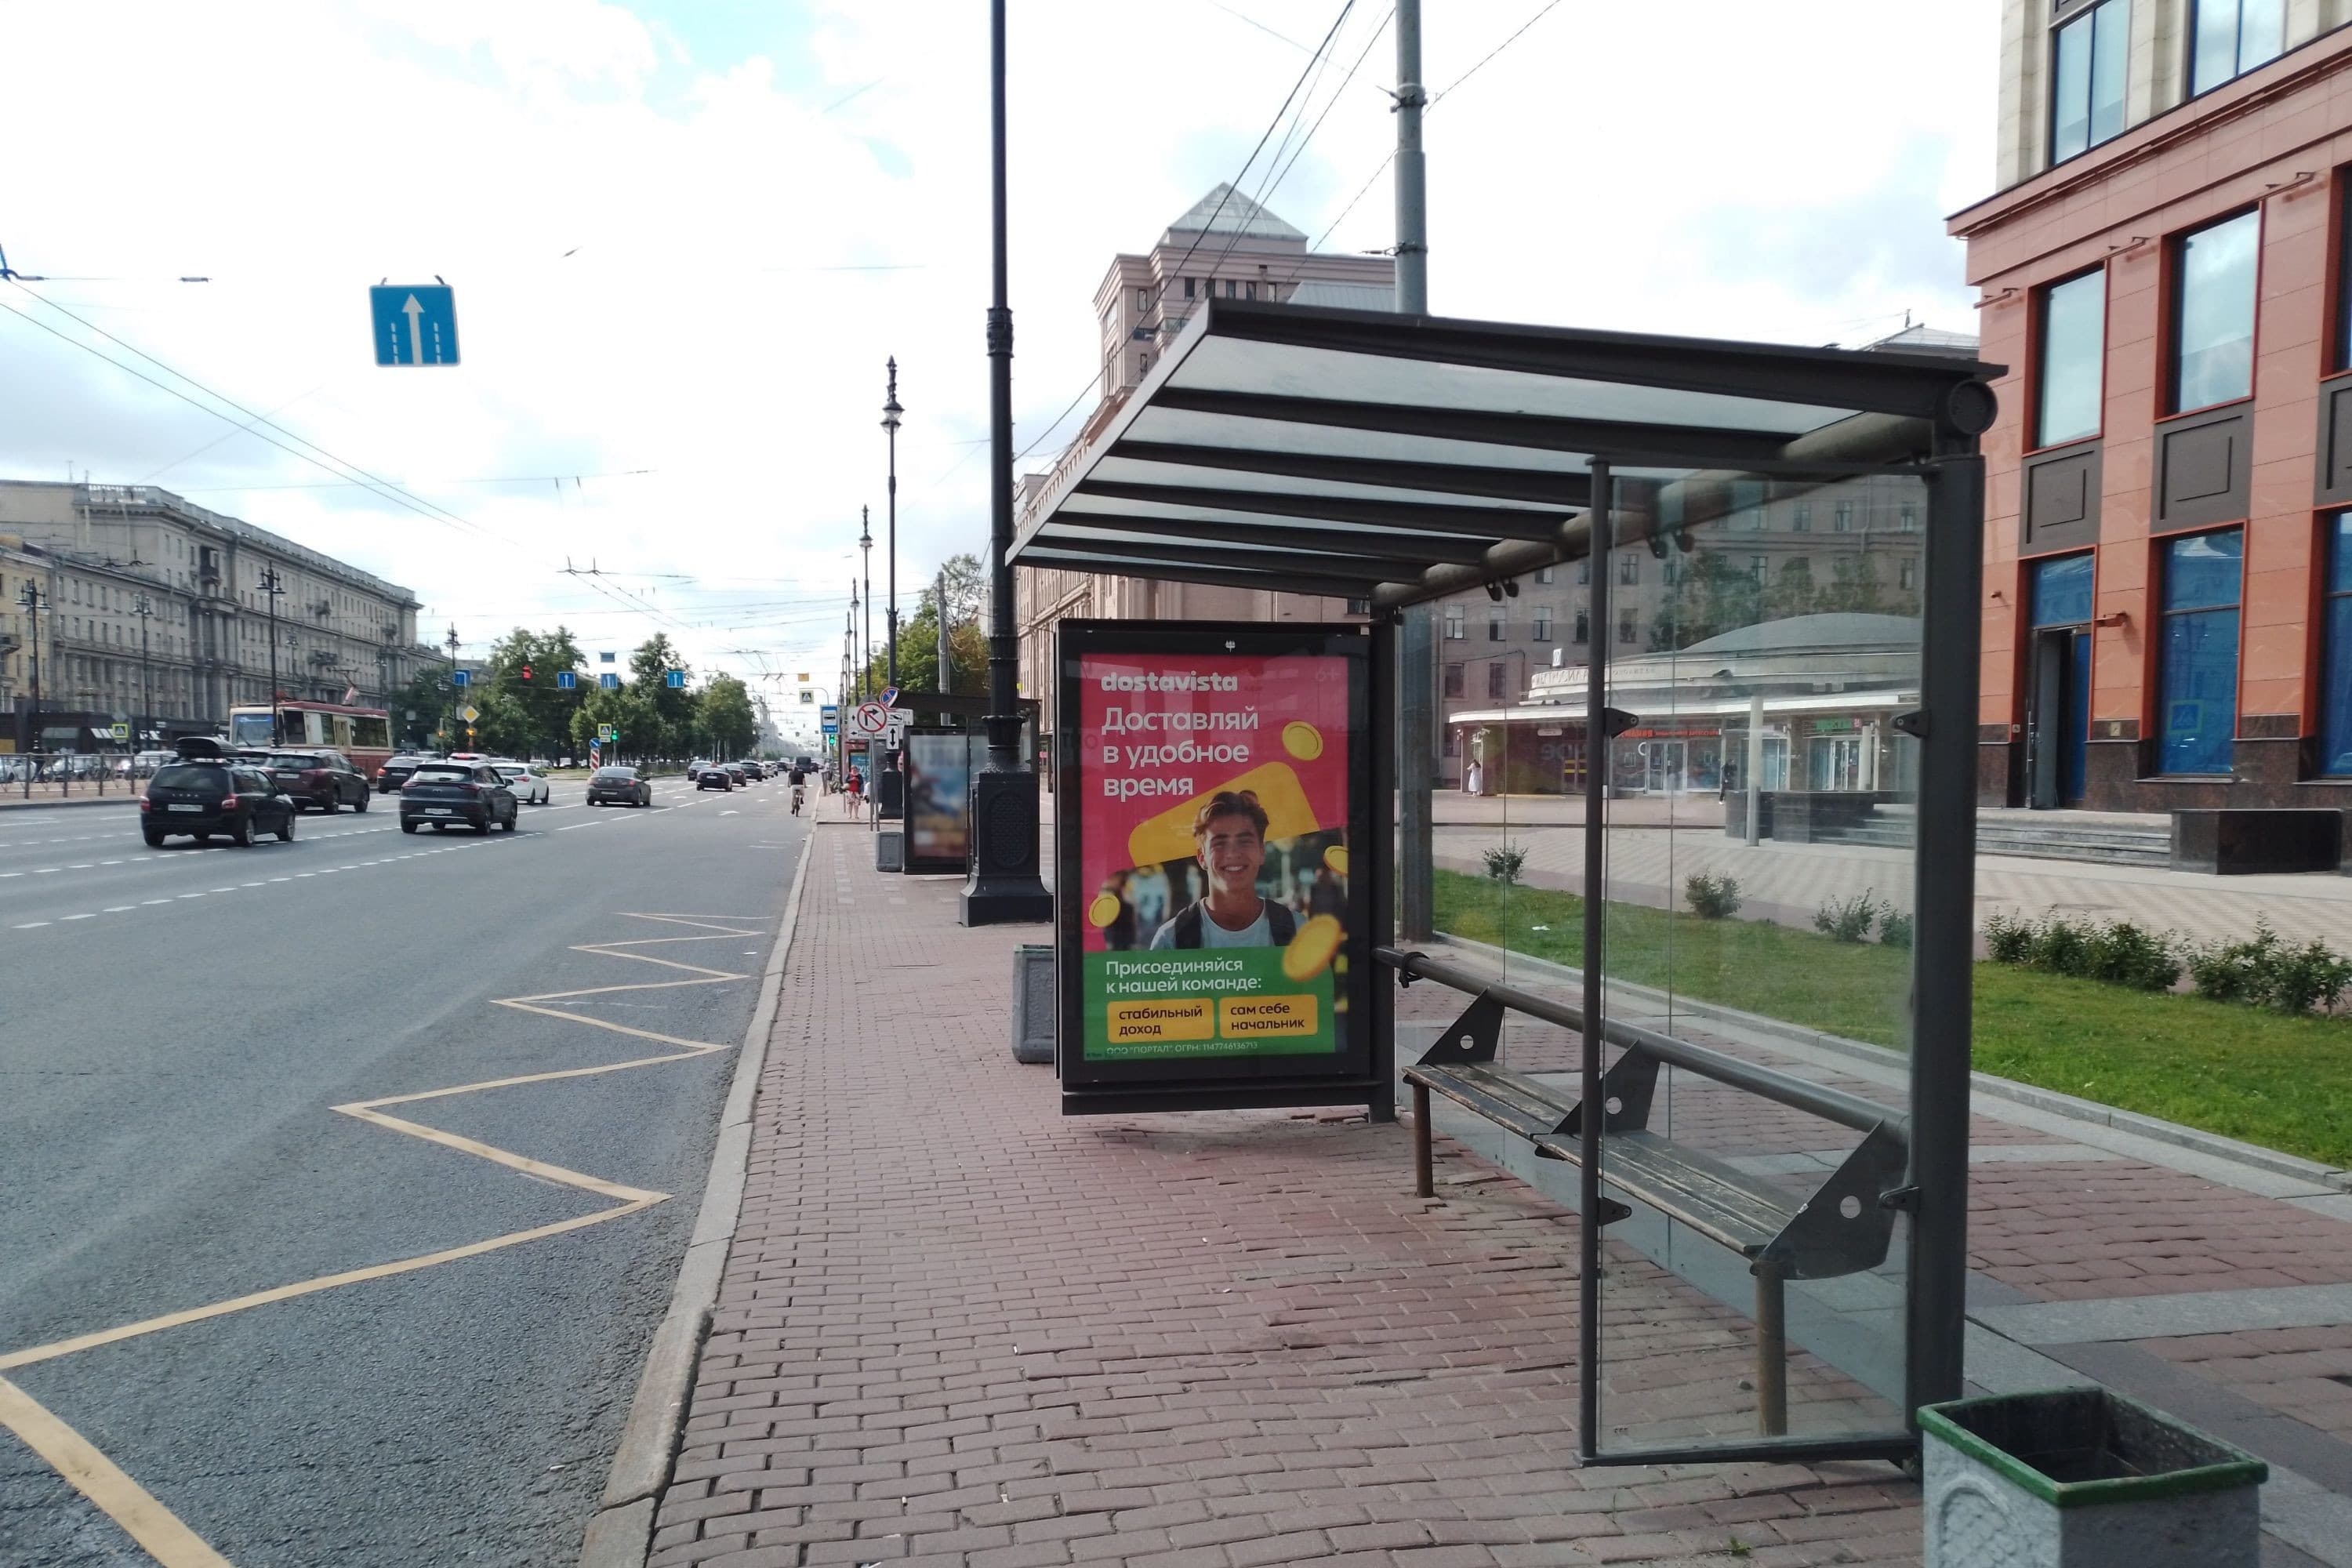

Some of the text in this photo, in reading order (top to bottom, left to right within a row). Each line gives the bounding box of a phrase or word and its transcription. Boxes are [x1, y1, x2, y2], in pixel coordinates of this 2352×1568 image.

[1101, 671, 1238, 691] dostavista
[1102, 706, 1258, 735] Доставляй
[1103, 740, 1250, 769] в удобное
[1104, 778, 1193, 802] время
[1106, 956, 1243, 978] Присоединяйся
[1106, 977, 1262, 994] к нашей команде:
[1119, 1005, 1203, 1020] стабильный
[1230, 1003, 1290, 1016] сам себе
[1119, 1024, 1162, 1037] доход
[1231, 1018, 1305, 1031] начальник
